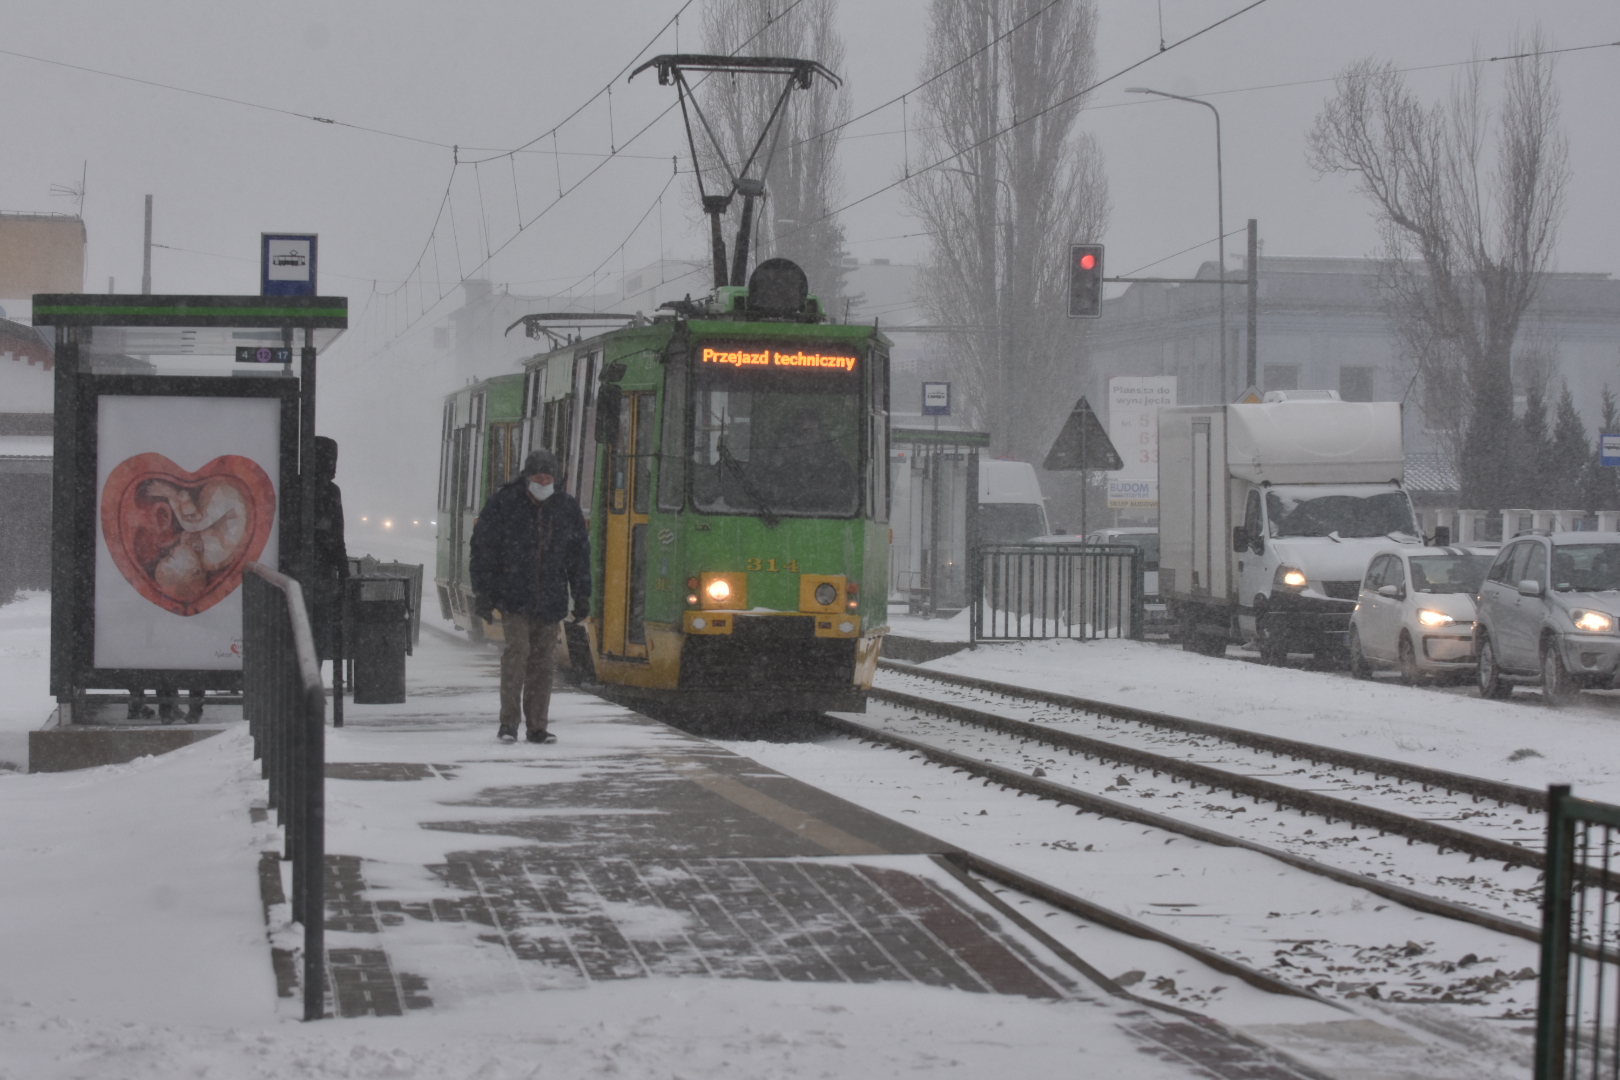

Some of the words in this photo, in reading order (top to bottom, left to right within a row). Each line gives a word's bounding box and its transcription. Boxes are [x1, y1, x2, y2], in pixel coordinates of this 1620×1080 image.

[242, 350, 249, 359] 4
[258, 351, 269, 359] 12
[277, 351, 288, 360] 17
[703, 348, 769, 367] Przejazd
[774, 351, 856, 371] techniczny
[1157, 386, 1171, 394] do
[1110, 482, 1150, 493] BUDOM
[747, 558, 800, 573] 314
